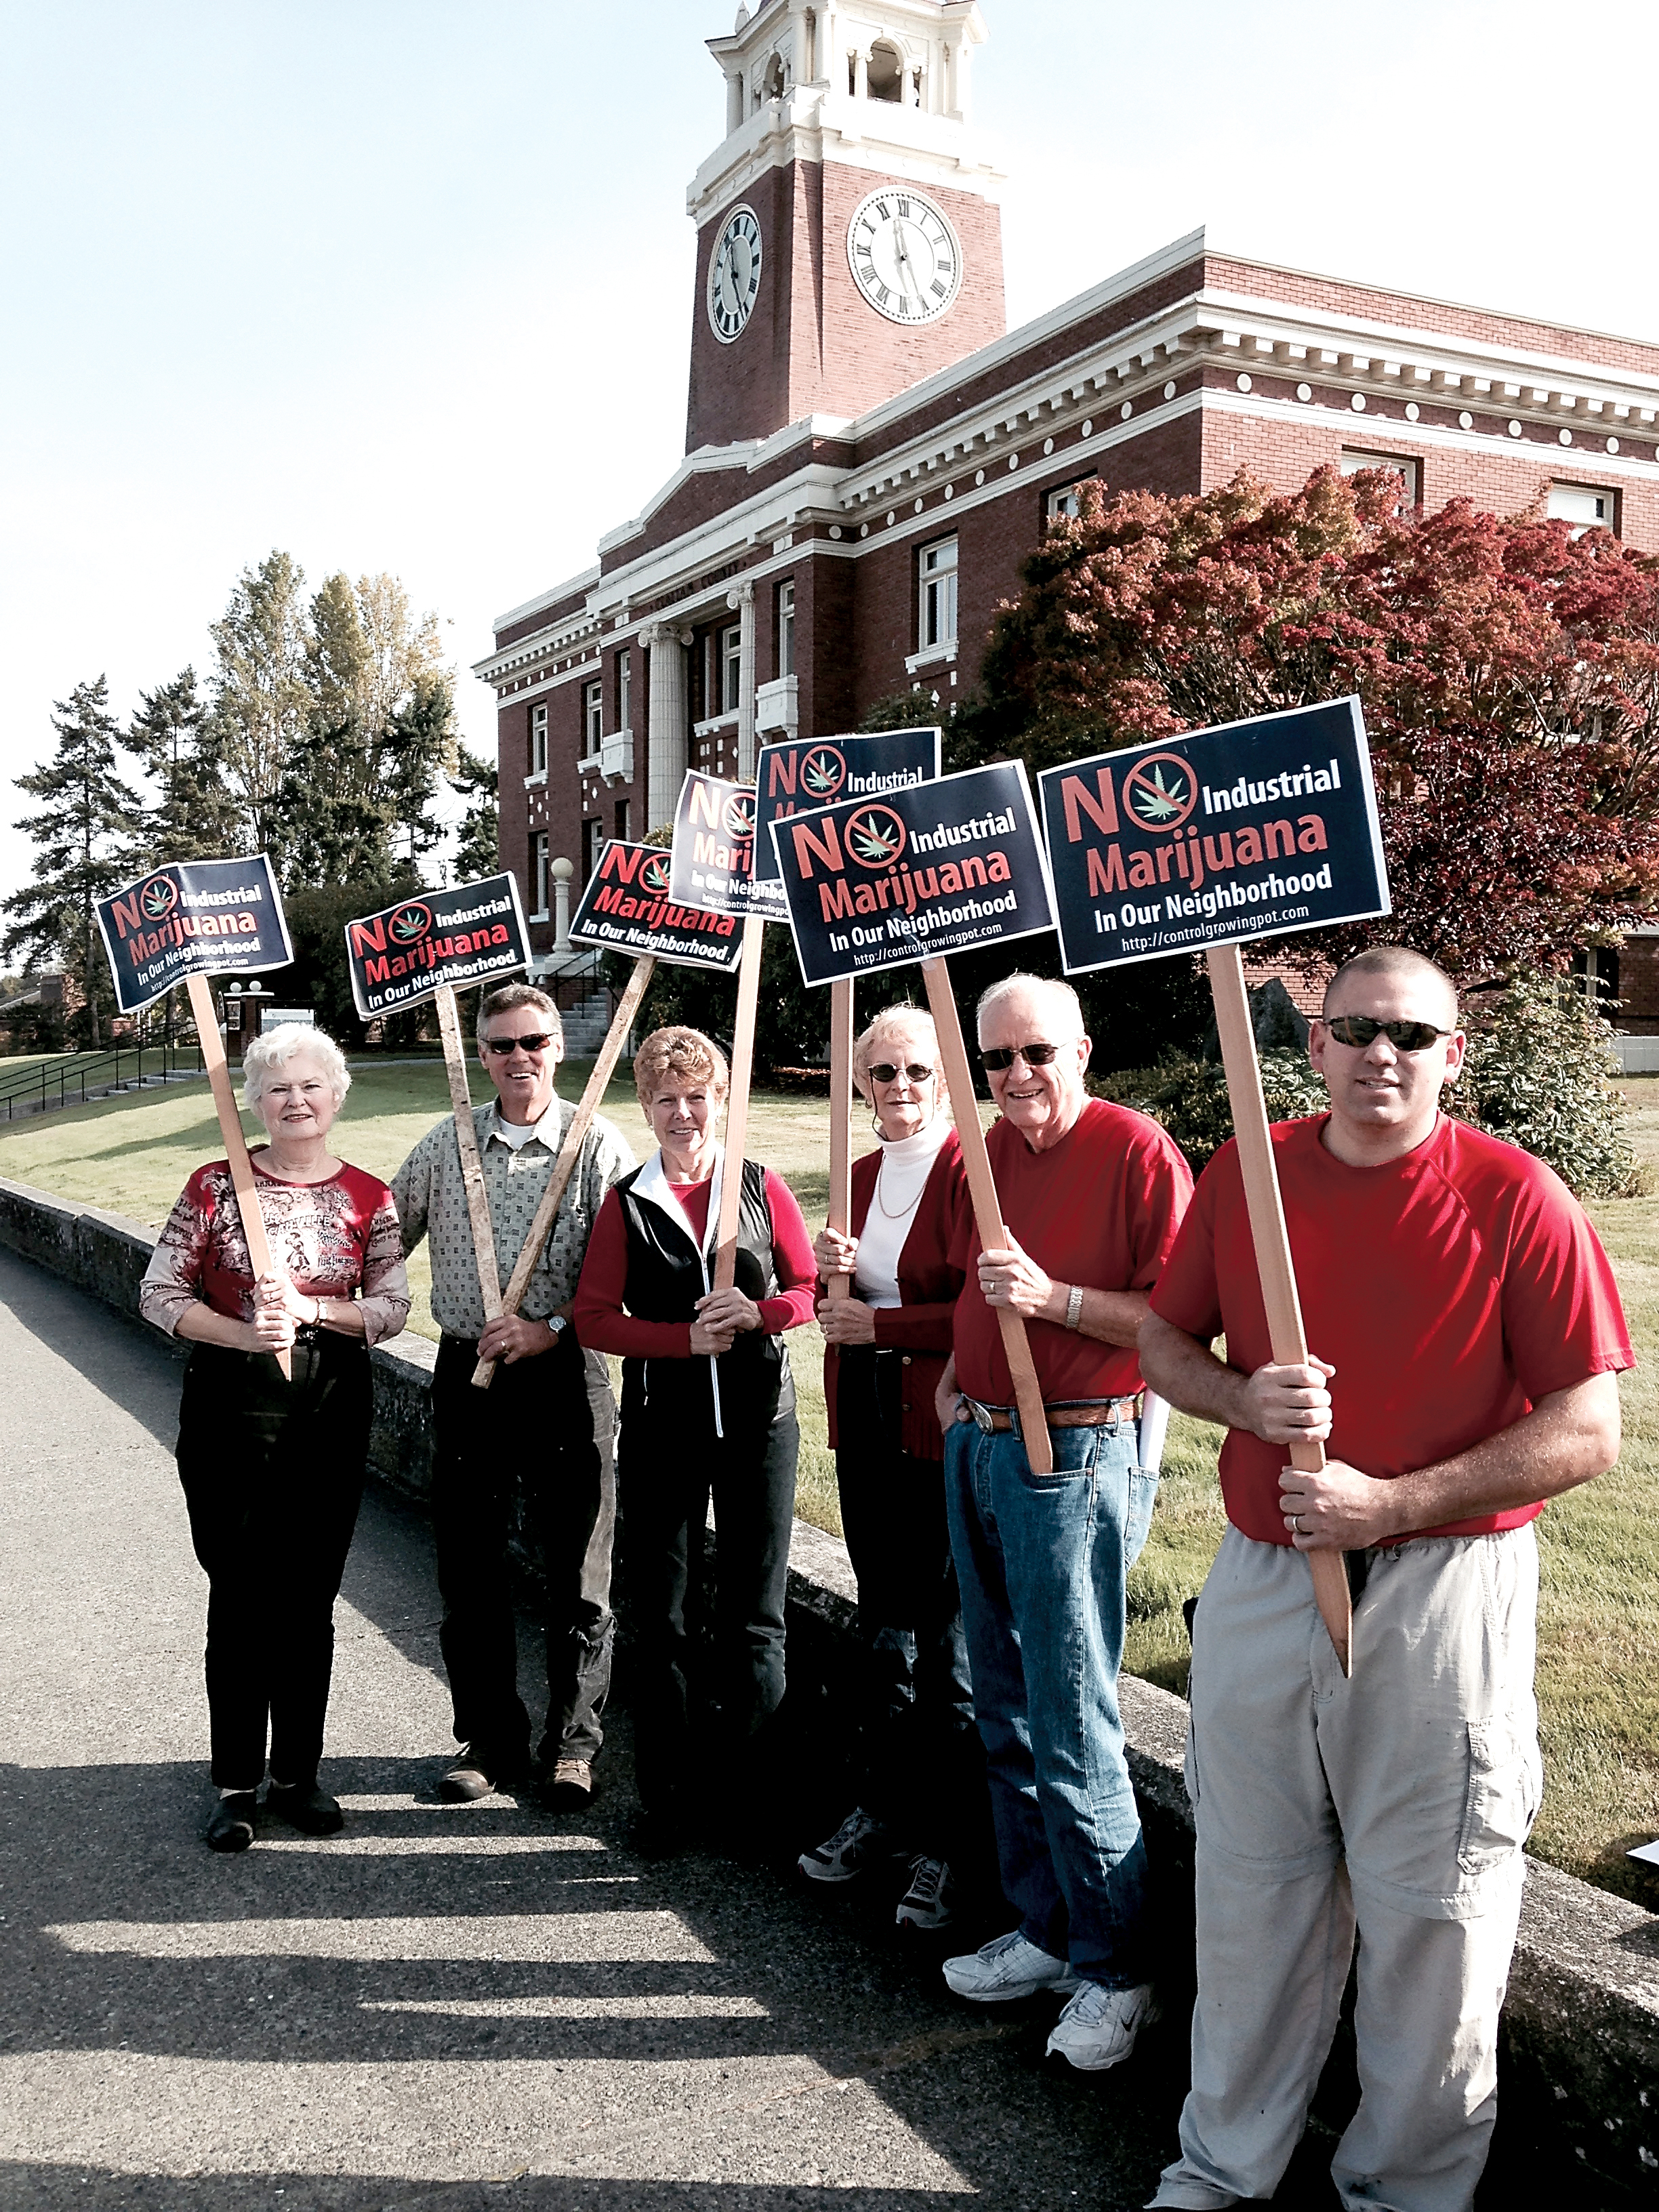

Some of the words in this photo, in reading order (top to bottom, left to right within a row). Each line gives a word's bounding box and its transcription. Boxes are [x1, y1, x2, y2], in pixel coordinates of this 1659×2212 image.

[861, 218, 877, 234] X
[848, 766, 923, 792] Industrial
[1202, 759, 1341, 815] Industrial
[692, 831, 754, 880] Marij
[909, 807, 1017, 855] Industrial
[1086, 813, 1328, 897] Marijuana
[180, 884, 262, 909] Industrial
[691, 869, 705, 888] In
[705, 873, 728, 893] Our
[729, 878, 786, 901] Neighbo
[818, 849, 1012, 924] Marijuana
[1094, 909, 1117, 933] In
[1120, 903, 1162, 928] Our
[1165, 863, 1332, 920] Neighborhood
[435, 895, 512, 928] Industrial
[593, 884, 736, 937] Marijuana
[829, 932, 848, 953] In
[852, 922, 883, 946] Our
[886, 889, 1017, 940] Neighborhood
[1121, 904, 1309, 952] http://controlgrowingpot.com
[127, 911, 257, 967] Marijuana
[137, 971, 148, 987] In
[148, 958, 166, 980] Our
[165, 937, 262, 968] Neighborhood
[364, 923, 509, 987] Marijuana
[581, 918, 598, 935] In
[598, 922, 626, 941] Our
[625, 927, 729, 961] Neighborhood
[853, 922, 1002, 966] http://controlgrowingpot.com
[368, 994, 383, 1010] In
[384, 983, 411, 1002] Our
[411, 951, 516, 991] Neighborhood
